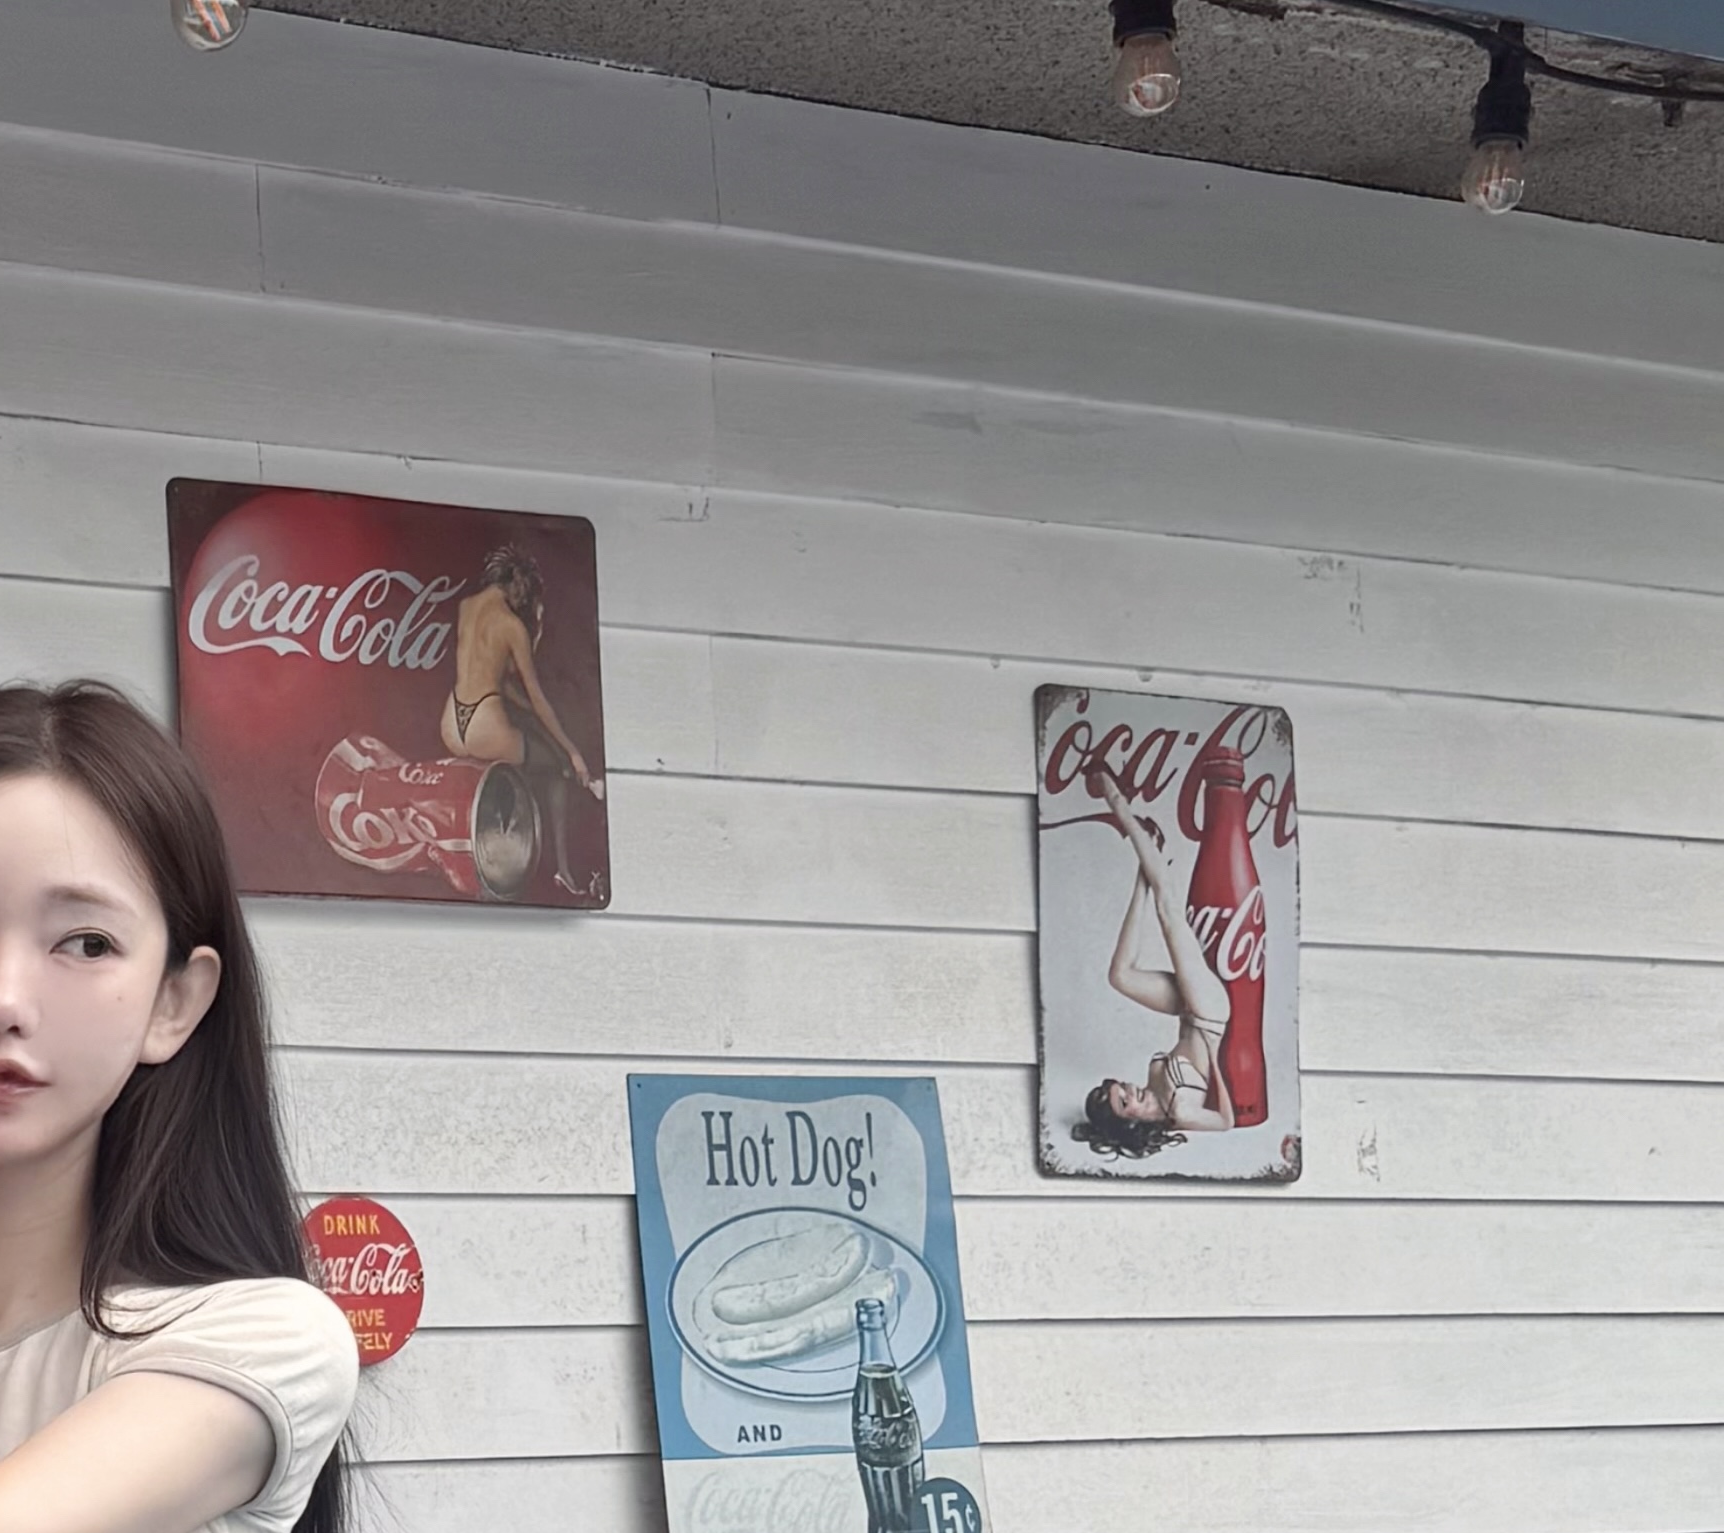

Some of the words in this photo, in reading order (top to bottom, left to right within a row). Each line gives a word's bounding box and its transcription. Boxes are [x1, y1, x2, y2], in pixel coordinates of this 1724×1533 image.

[188, 554, 469, 670] Coca-Cola
[701, 1111, 777, 1187] Hot
[785, 1110, 877, 1212] Dog!
[323, 1214, 381, 1236] DRINK
[345, 1308, 386, 1327] RIVE
[737, 1423, 784, 1444] AND
